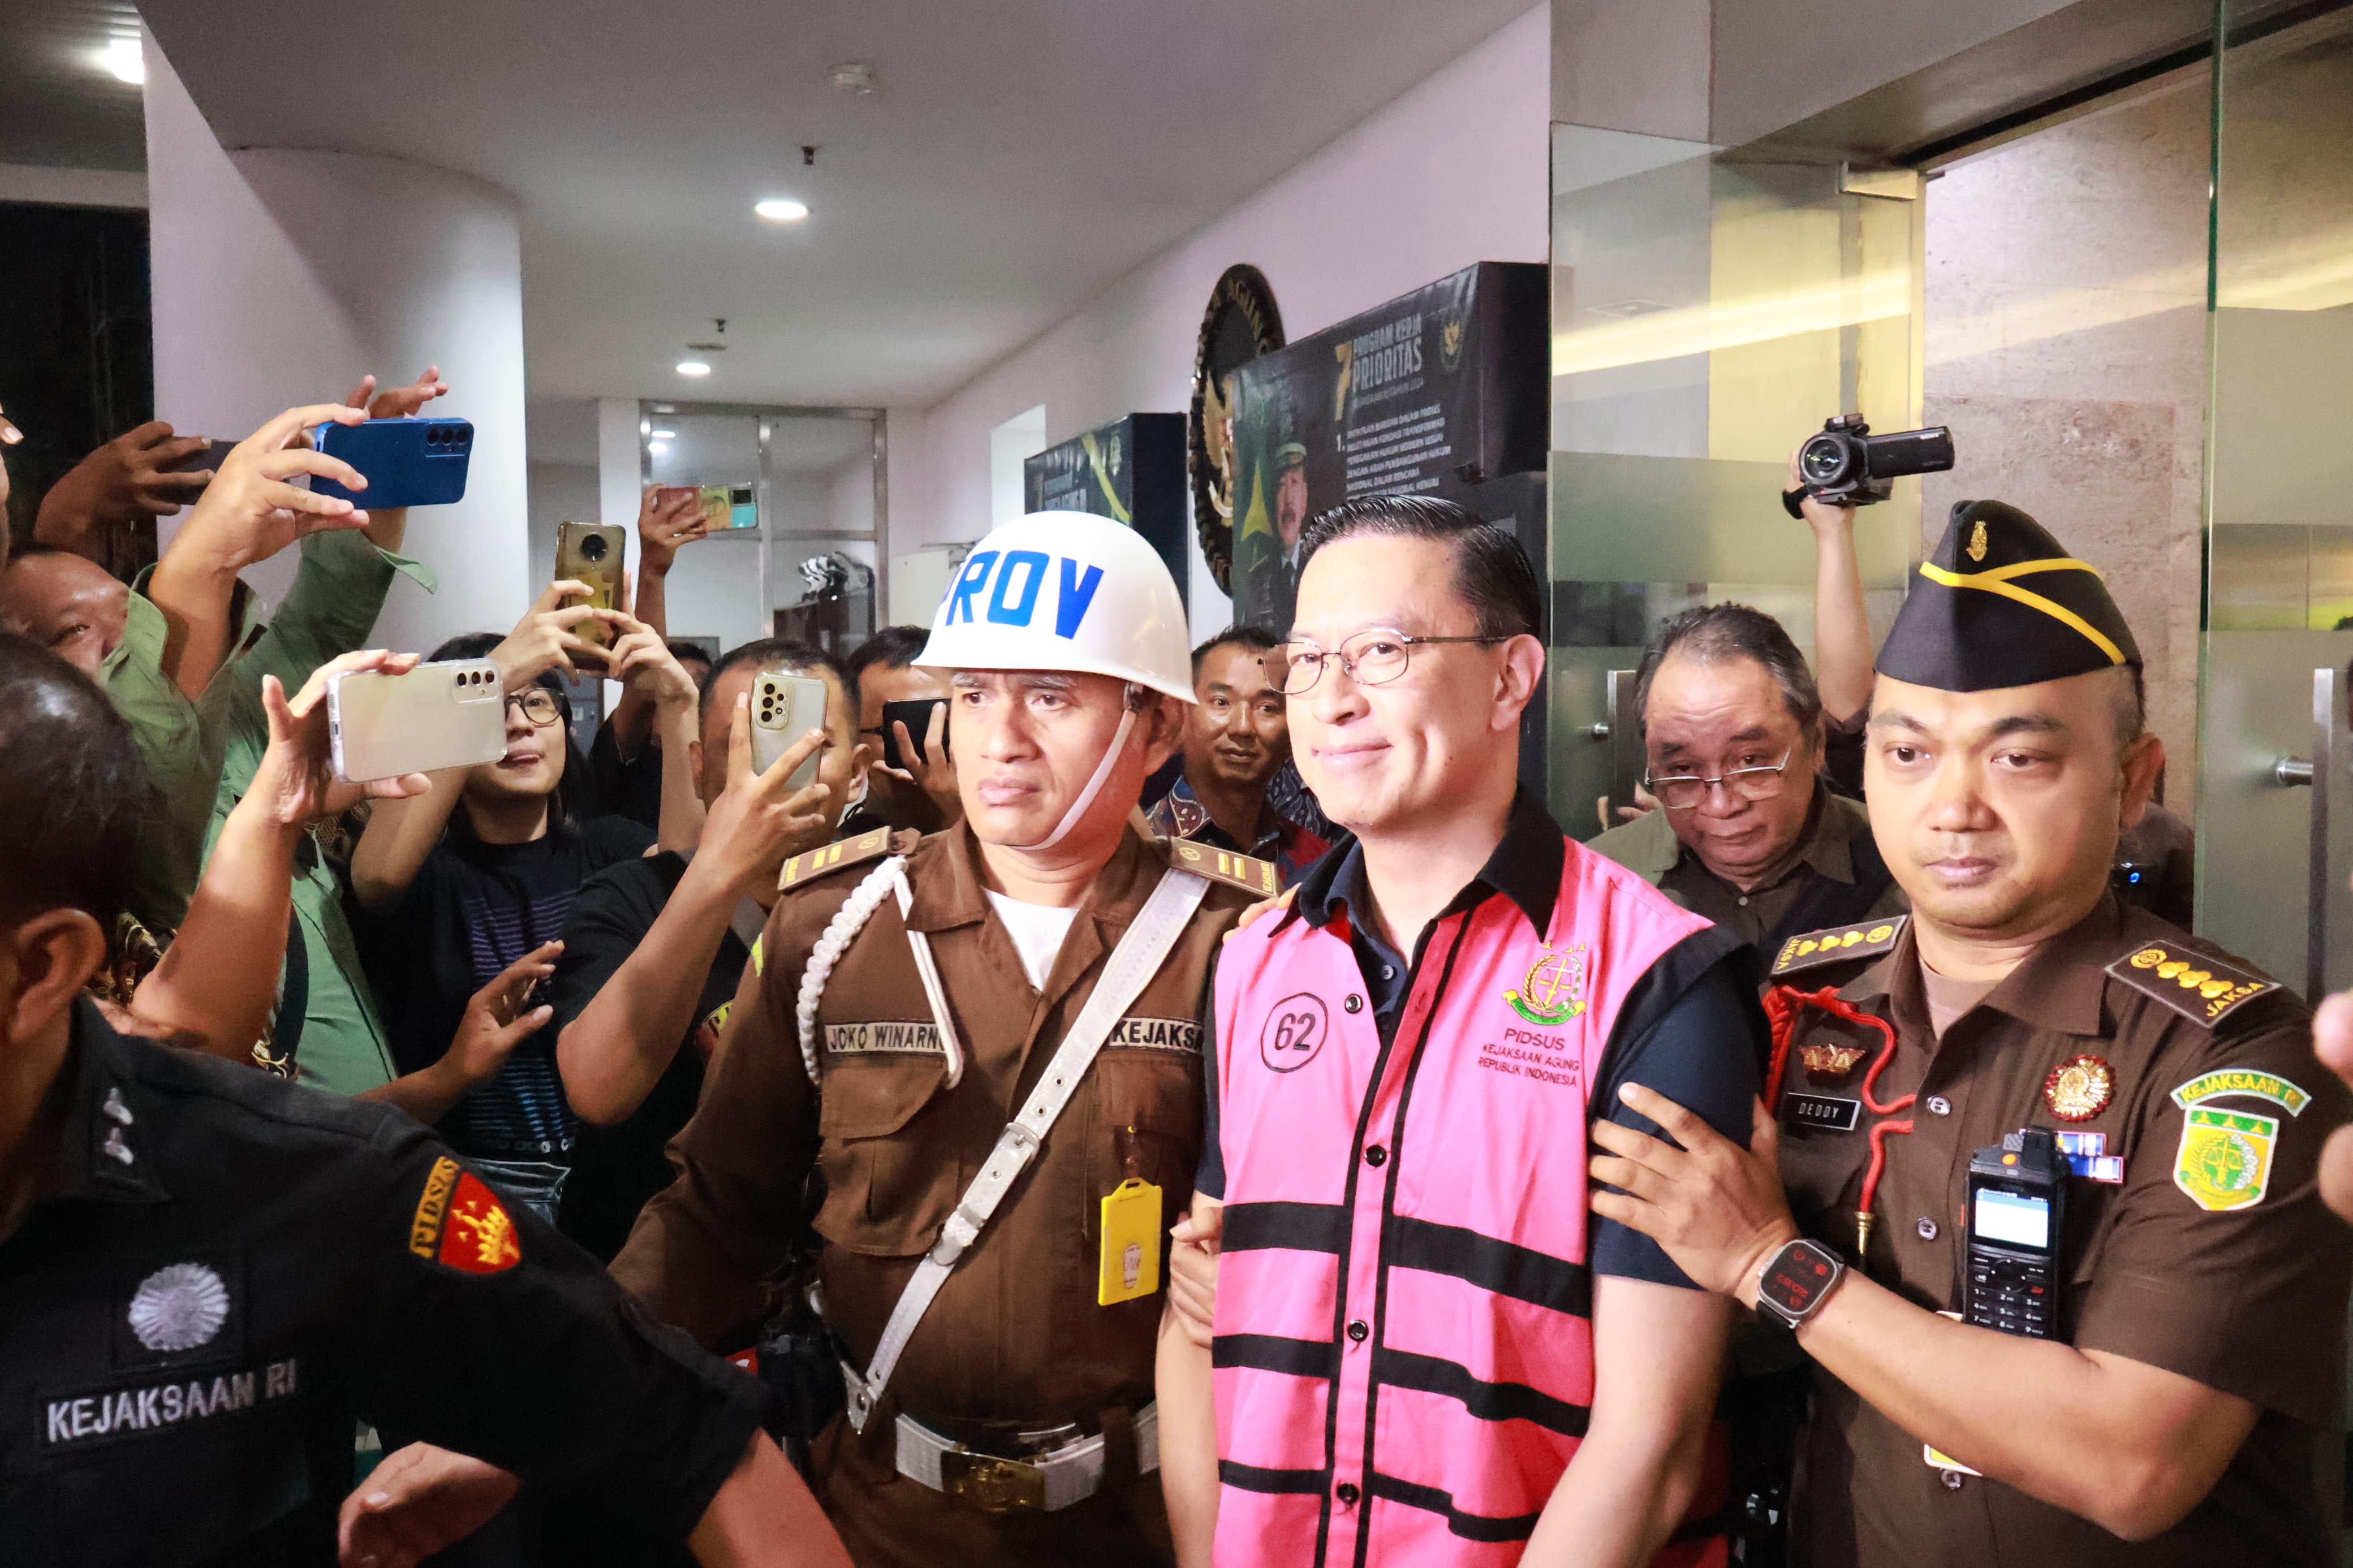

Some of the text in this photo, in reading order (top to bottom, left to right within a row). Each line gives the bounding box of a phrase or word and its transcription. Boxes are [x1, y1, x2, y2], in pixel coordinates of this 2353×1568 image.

[1334, 340, 1352, 422] 7
[1352, 337, 1423, 393] PRIORITAS
[940, 550, 1104, 640] ROV
[1777, 939, 1802, 970] JAKSA
[2207, 982, 2265, 1017] JAKSA
[831, 1026, 868, 1050] JOKO
[1274, 1012, 1316, 1051] 62
[1504, 1027, 1566, 1051] PIDSUS
[1478, 1056, 1577, 1087] REPUBLIK INDONESIA
[1482, 1043, 1579, 1072] KEJAKSAAN AGUNG
[2180, 1073, 2281, 1102] KEJAKSAAN
[47, 1359, 296, 1442] KEJAKSAAN RI
